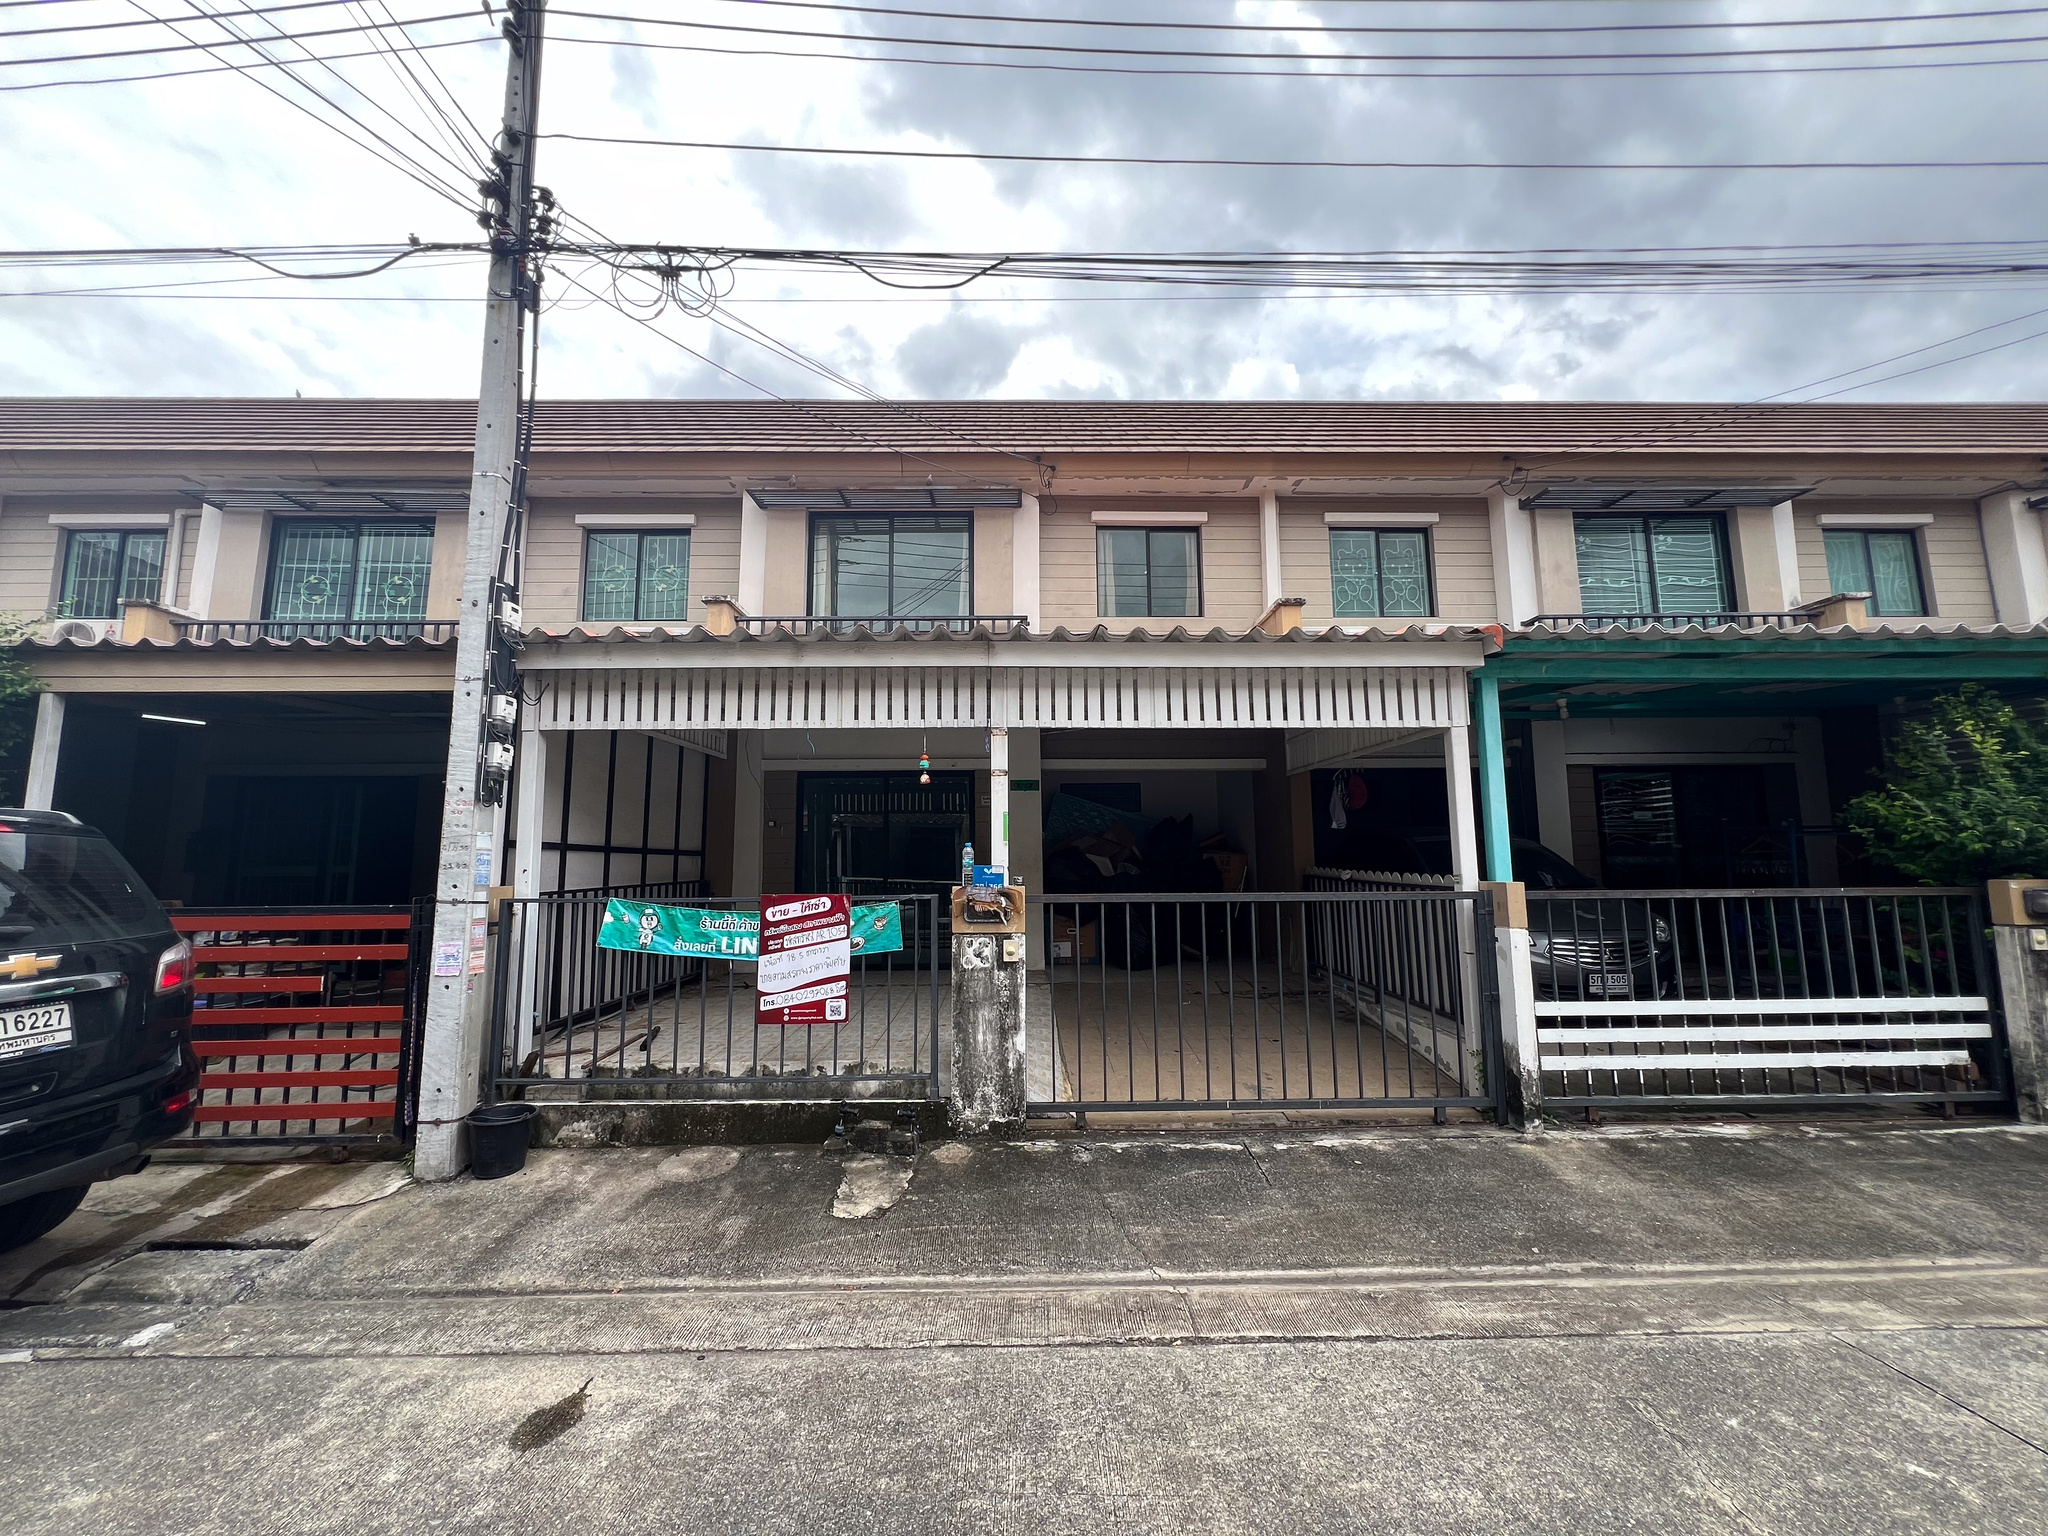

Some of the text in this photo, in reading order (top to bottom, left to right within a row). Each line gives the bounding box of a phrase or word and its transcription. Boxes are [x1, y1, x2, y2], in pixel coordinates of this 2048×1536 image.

[771, 907, 790, 918] ขาย
[800, 899, 826, 914] ให้เช่า
[701, 915, 736, 930] ร้านนี้ดี
[673, 936, 716, 953] สั่งเลยที่
[1611, 975, 1627, 984] 505
[14, 1008, 65, 1032] 6227
